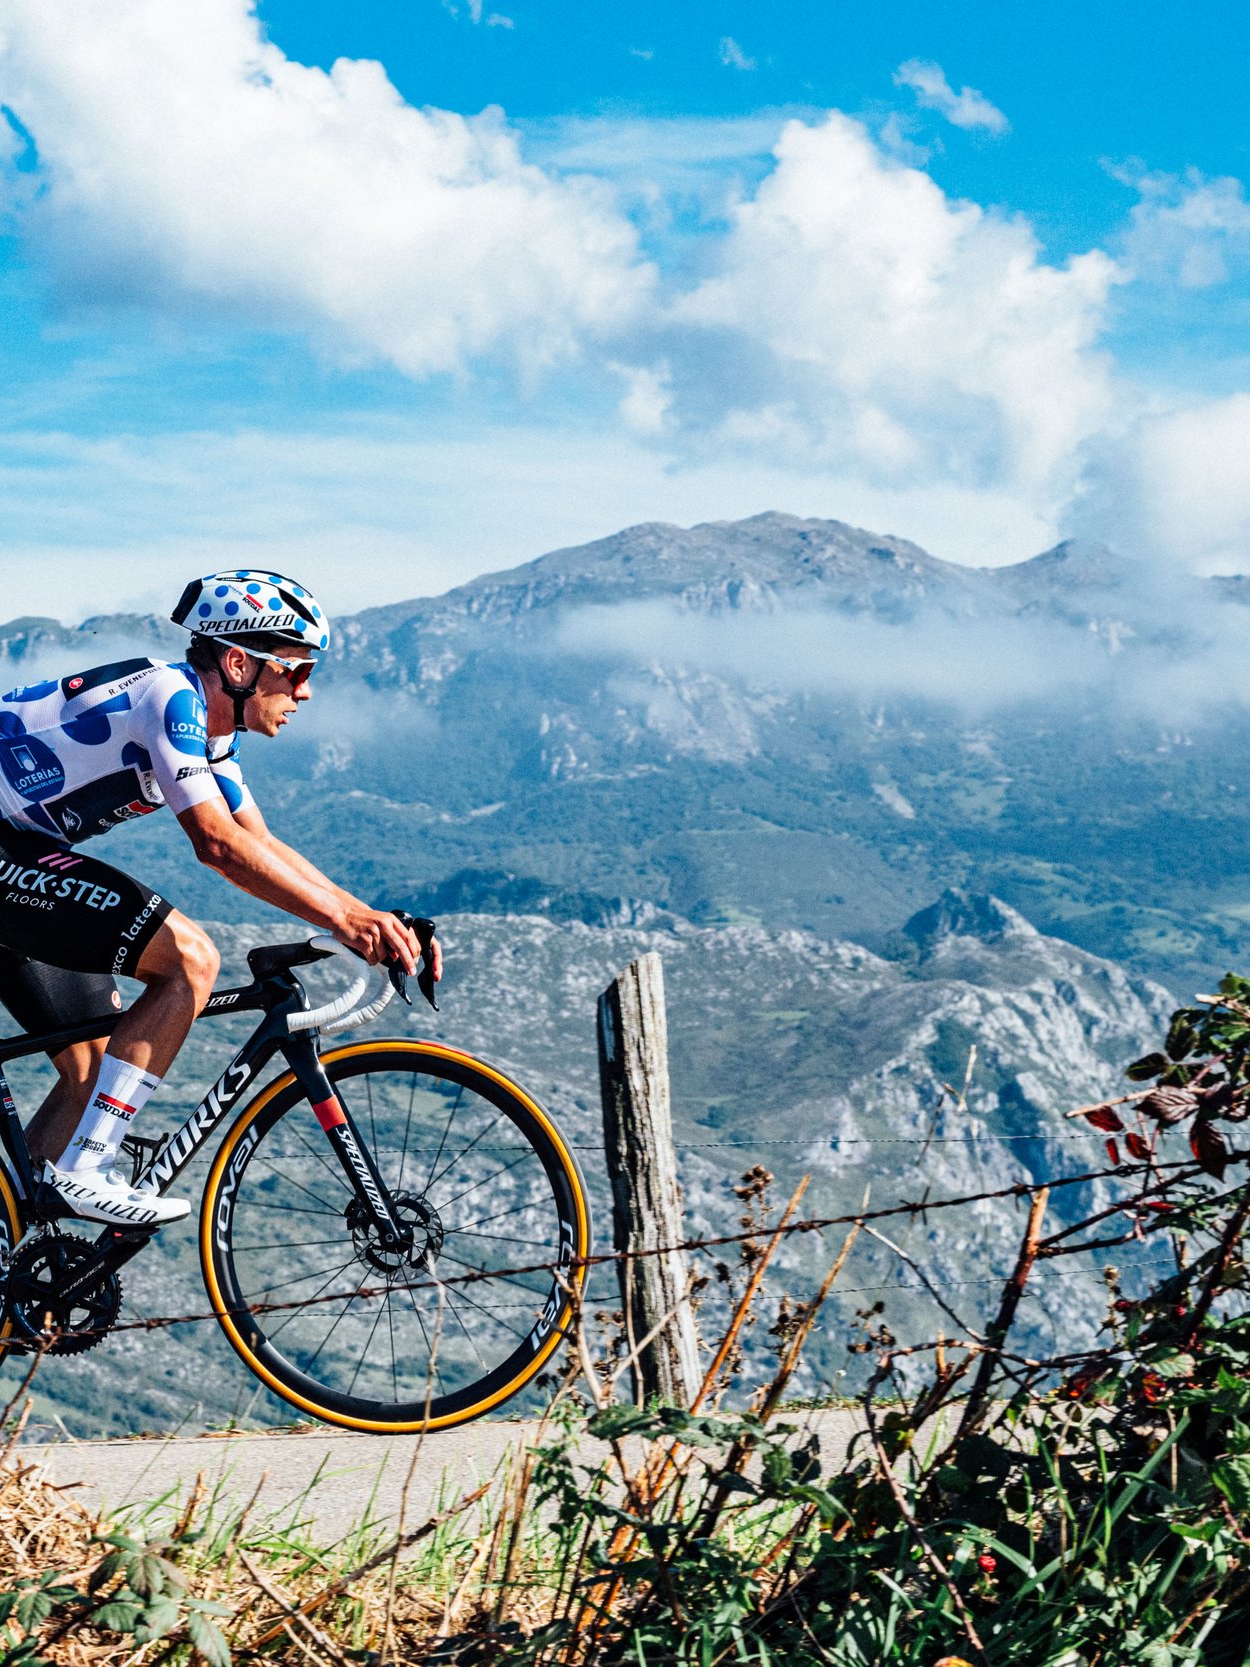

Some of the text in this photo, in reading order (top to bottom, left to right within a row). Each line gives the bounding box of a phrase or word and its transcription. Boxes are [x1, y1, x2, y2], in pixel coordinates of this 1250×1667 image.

[242, 596, 260, 613] SOUDAL
[198, 614, 295, 633] SPECIALIZED
[14, 767, 61, 790] LOTERÍAS
[5, 892, 56, 911] FLOORS
[93, 1099, 131, 1121] SOUDAL
[335, 1127, 390, 1220] SPECIALIZED
[217, 1124, 259, 1252] roval
